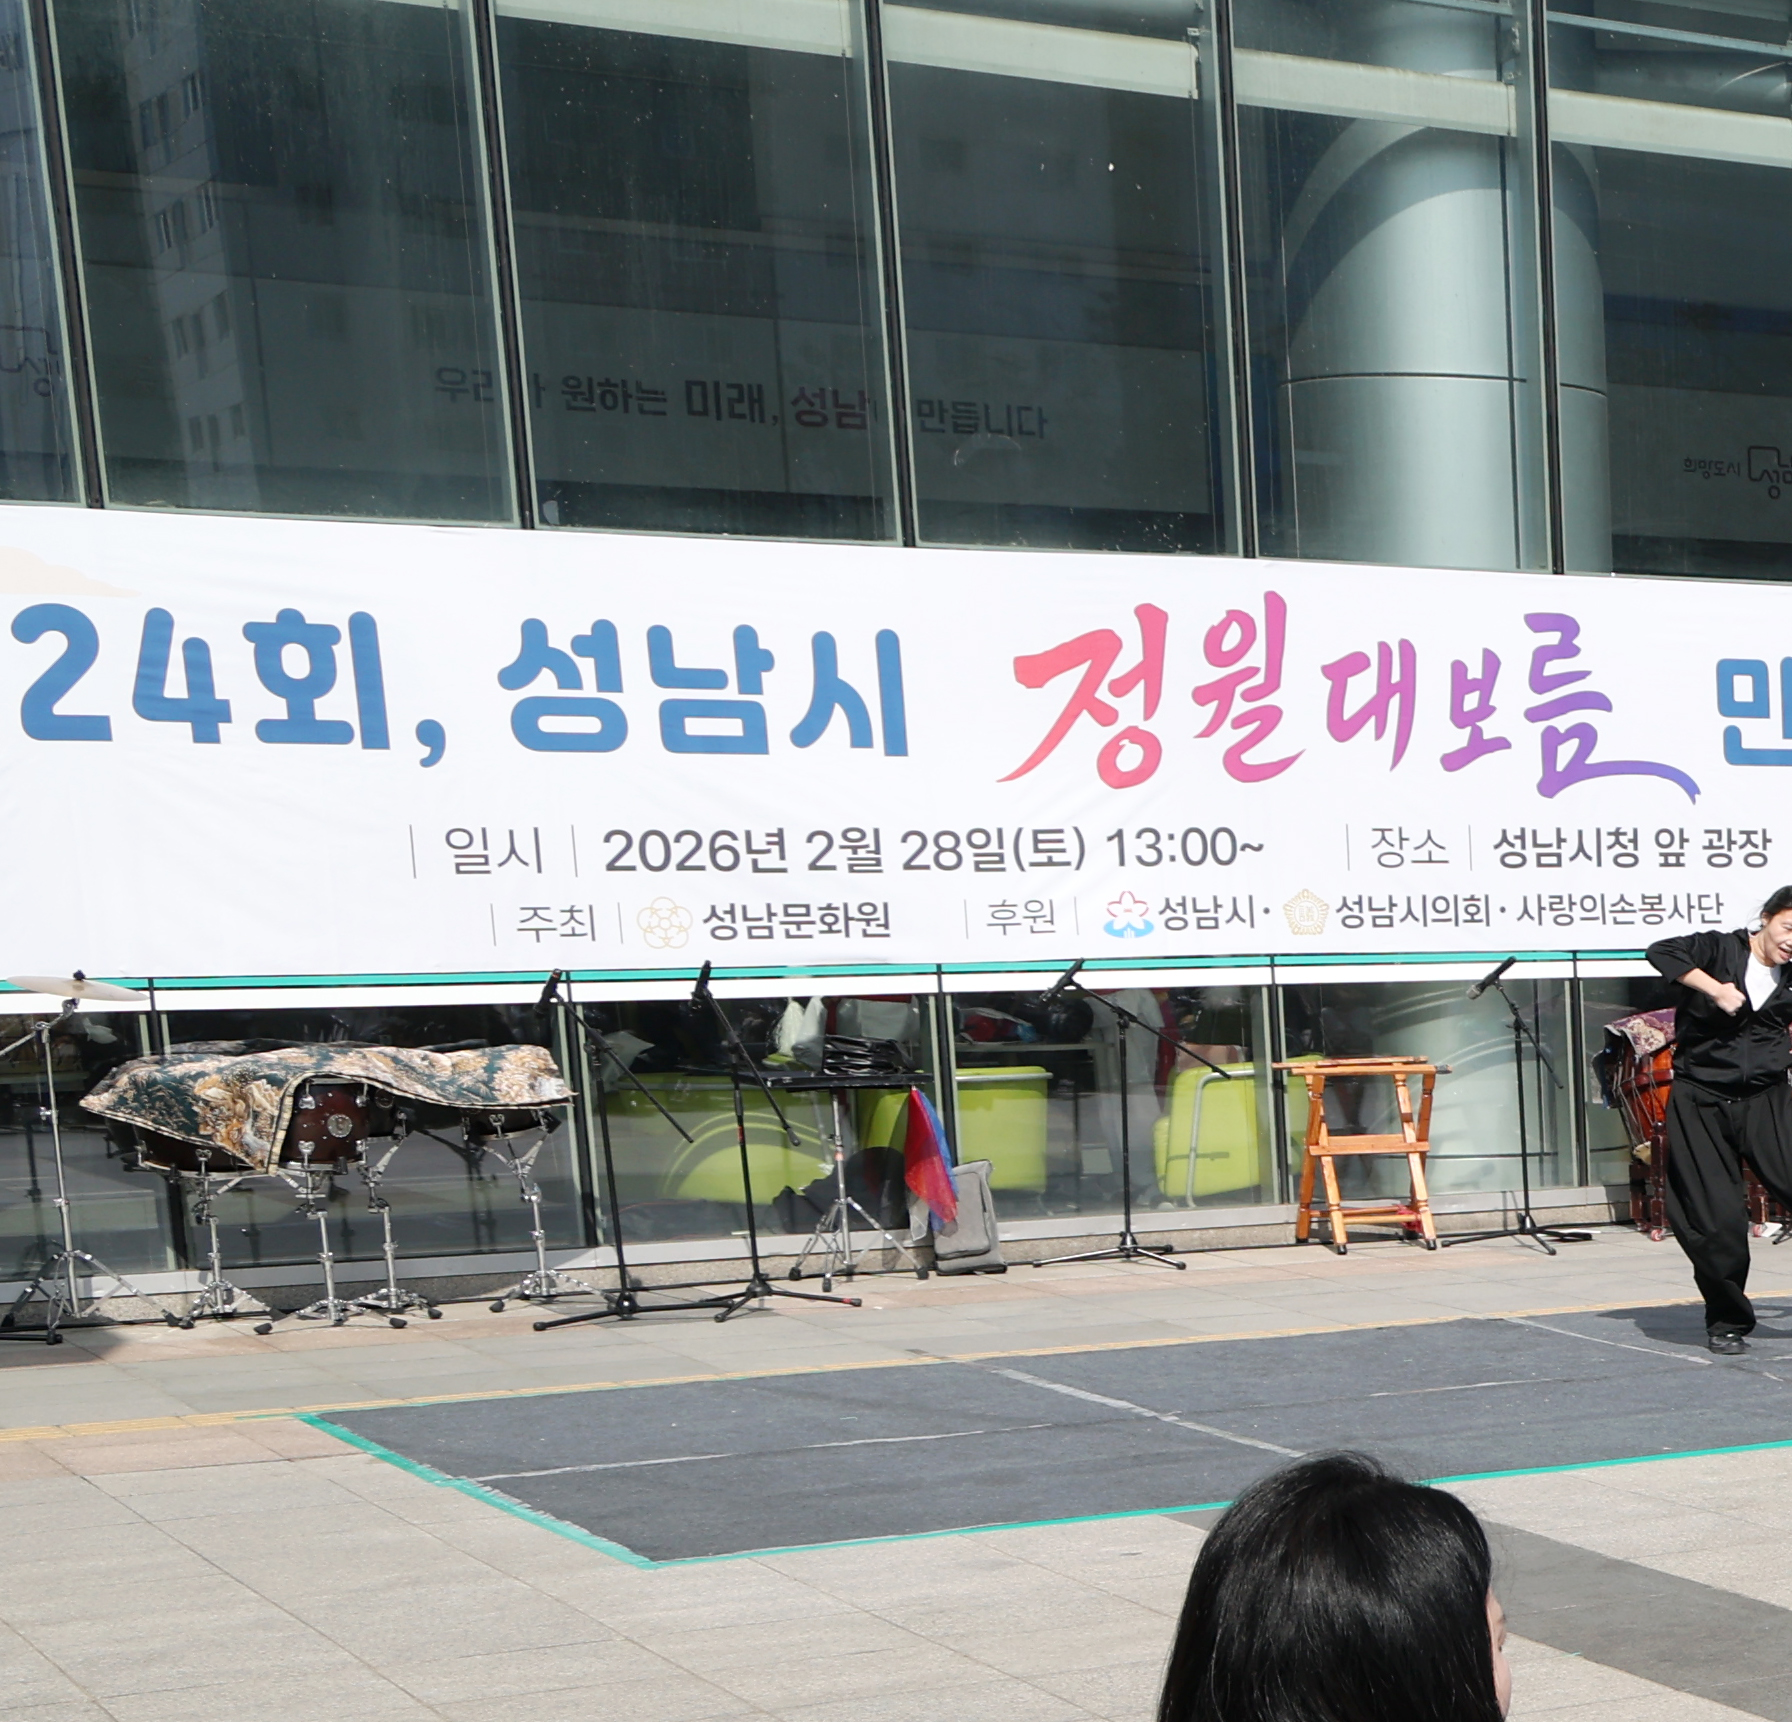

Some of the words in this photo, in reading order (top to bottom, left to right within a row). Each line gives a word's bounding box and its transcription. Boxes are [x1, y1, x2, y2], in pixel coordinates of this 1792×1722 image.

[561, 374, 668, 417] 원하는
[685, 379, 779, 427] 미래,
[917, 398, 1048, 438] 만듭니다
[1683, 456, 1741, 479] 희망도시
[11, 603, 445, 767] 24회,
[498, 619, 908, 756] 성남시
[999, 590, 1701, 803] 정월대보름
[446, 827, 541, 874] 일시
[604, 828, 787, 873] 2026년
[807, 828, 883, 873] 2월
[901, 827, 1085, 872] 28일(토)
[1107, 827, 1263, 866] 13:00~
[1372, 827, 1449, 868] 장소
[1494, 827, 1639, 868] 성남시청
[1655, 828, 1689, 867] 앞
[1703, 828, 1772, 868] 광장
[517, 905, 595, 942] 주최
[704, 902, 890, 940] 성남문화원
[988, 900, 1054, 935] 후원
[1517, 893, 1725, 927] 사랑의손봉사단
